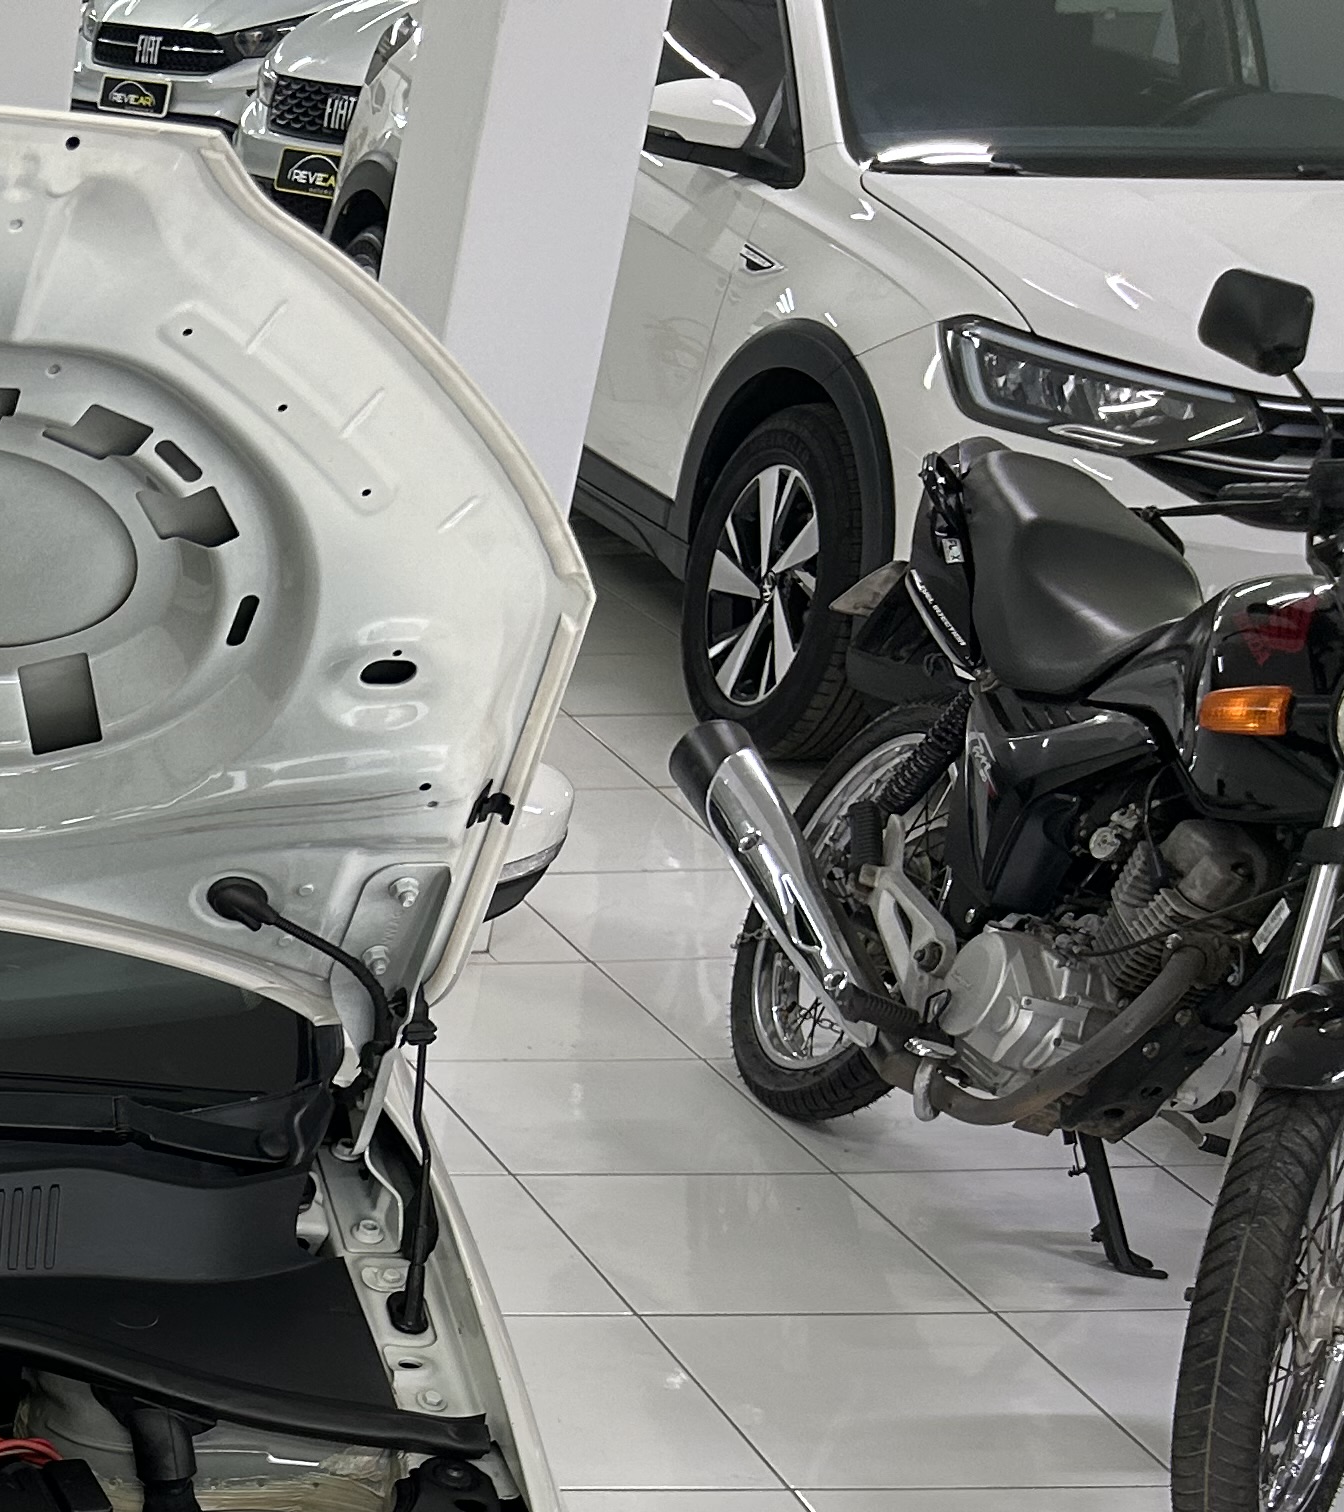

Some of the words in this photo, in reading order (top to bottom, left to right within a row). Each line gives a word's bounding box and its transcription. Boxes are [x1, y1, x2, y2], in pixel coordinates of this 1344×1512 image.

[135, 35, 163, 65] FIAT
[323, 95, 358, 131] FIAT
[291, 169, 338, 187] REVECA
[947, 539, 962, 561] FLX
